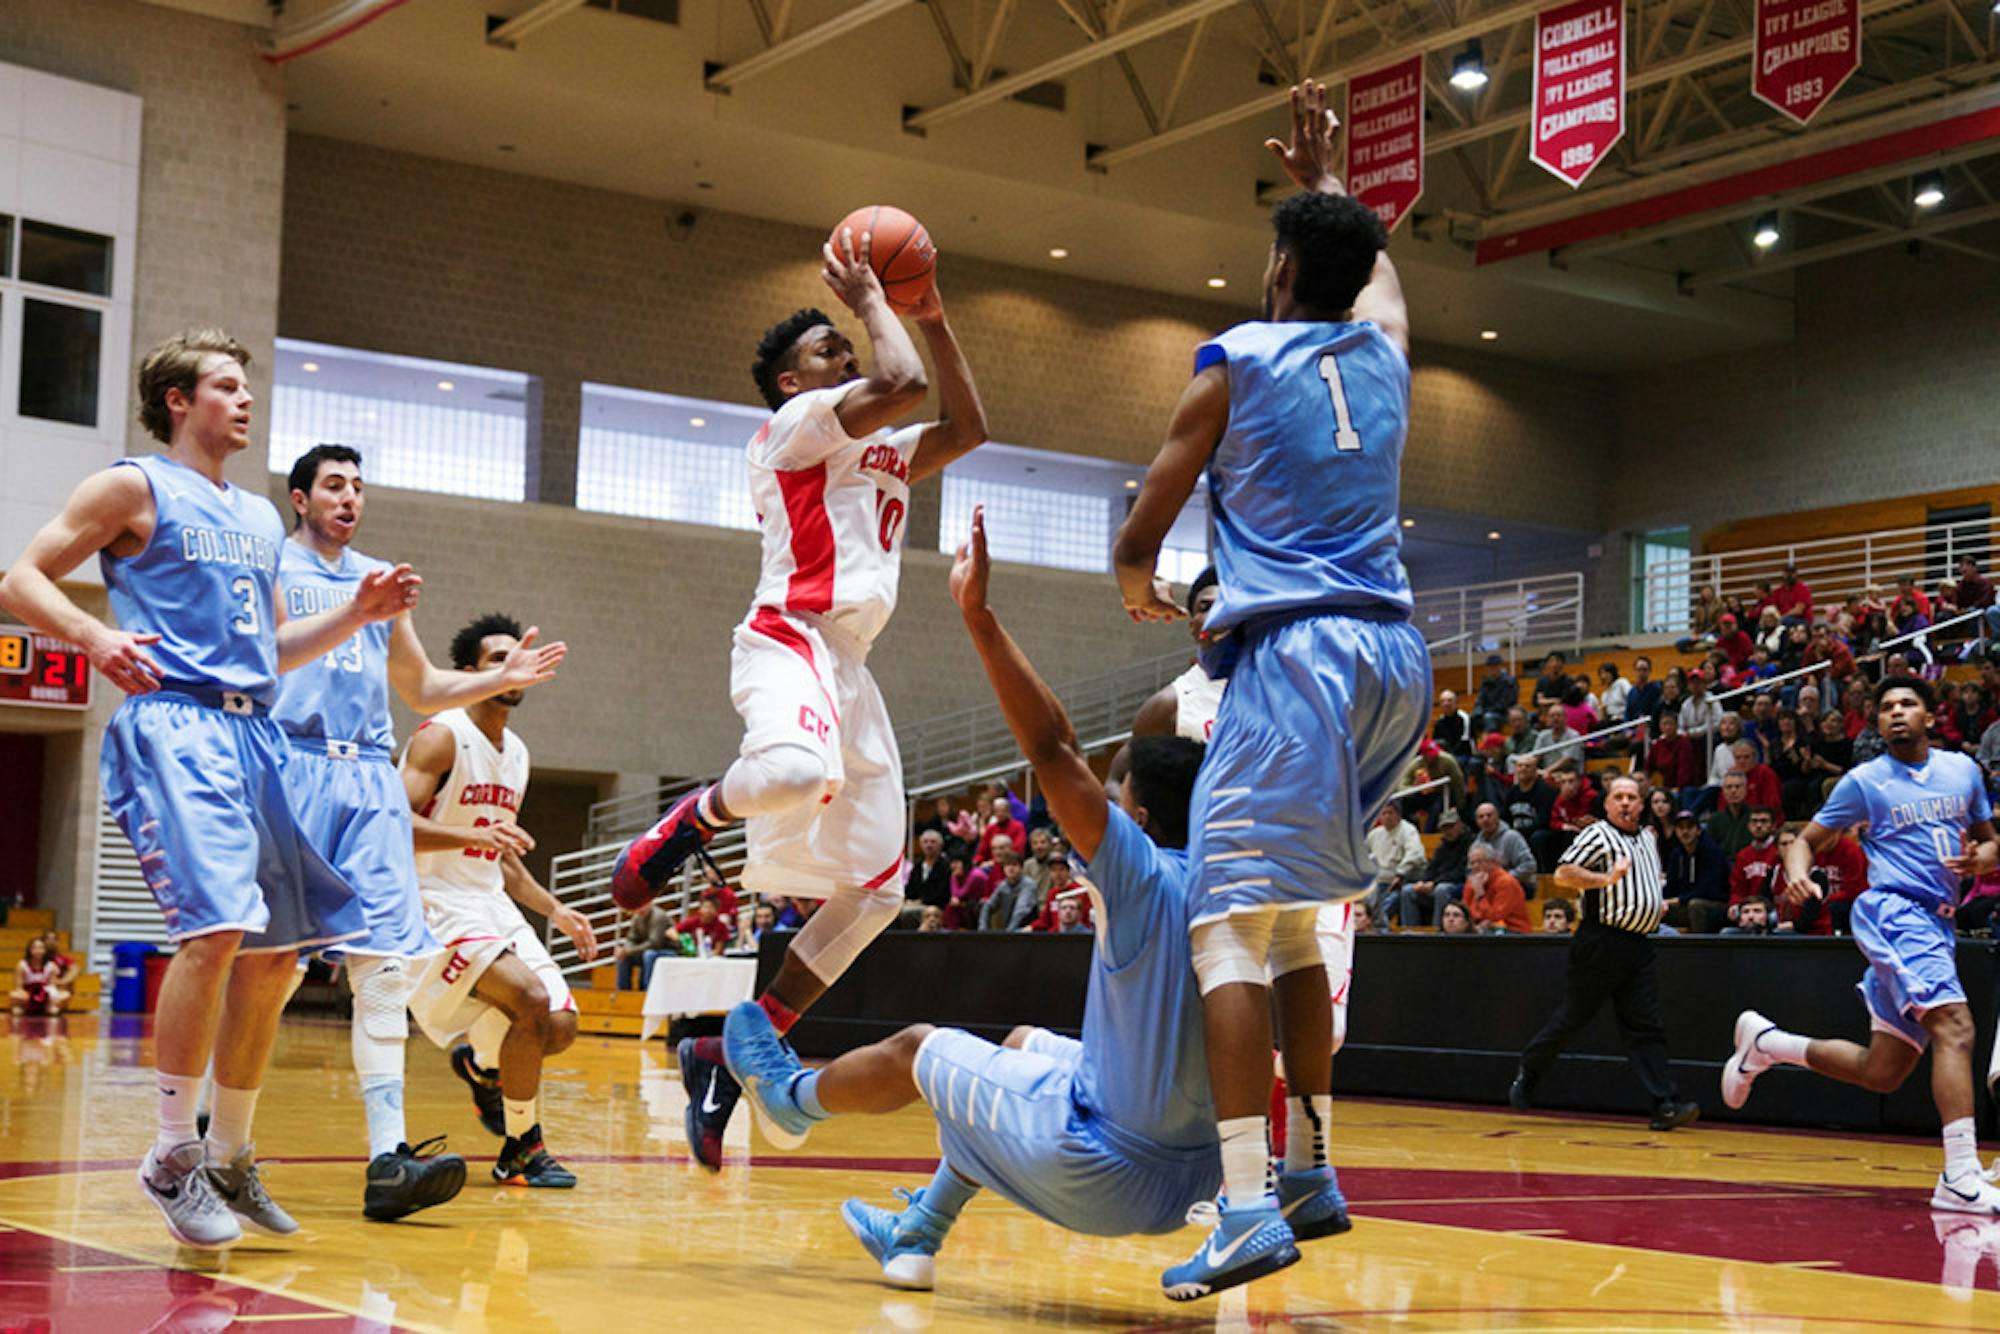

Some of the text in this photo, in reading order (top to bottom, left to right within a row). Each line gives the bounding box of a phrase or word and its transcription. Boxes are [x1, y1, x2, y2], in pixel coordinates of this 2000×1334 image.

[1542, 6, 1616, 50] CORNELL
[1765, 0, 1847, 37] IVY LEAGUE
[1543, 40, 1615, 77] VOLLEYBALL
[1763, 26, 1850, 75] CHAMPIONS
[1352, 74, 1417, 114] CORNELL
[1545, 69, 1613, 106] IVY LEAGUE
[1786, 77, 1823, 106] 1993
[1352, 106, 1415, 139] VOLLEYBALL
[1540, 97, 1616, 142] CHAMPIONS
[1373, 132, 1414, 160] LEAGUE
[1351, 159, 1417, 193] CHAMPIONS
[1319, 354, 1361, 449] 1
[232, 577, 259, 635] 3
[44, 653, 86, 687] 21
[1891, 795, 1968, 830] COLUMBIA
[1932, 827, 1953, 864] 0
[442, 950, 470, 985] CU
